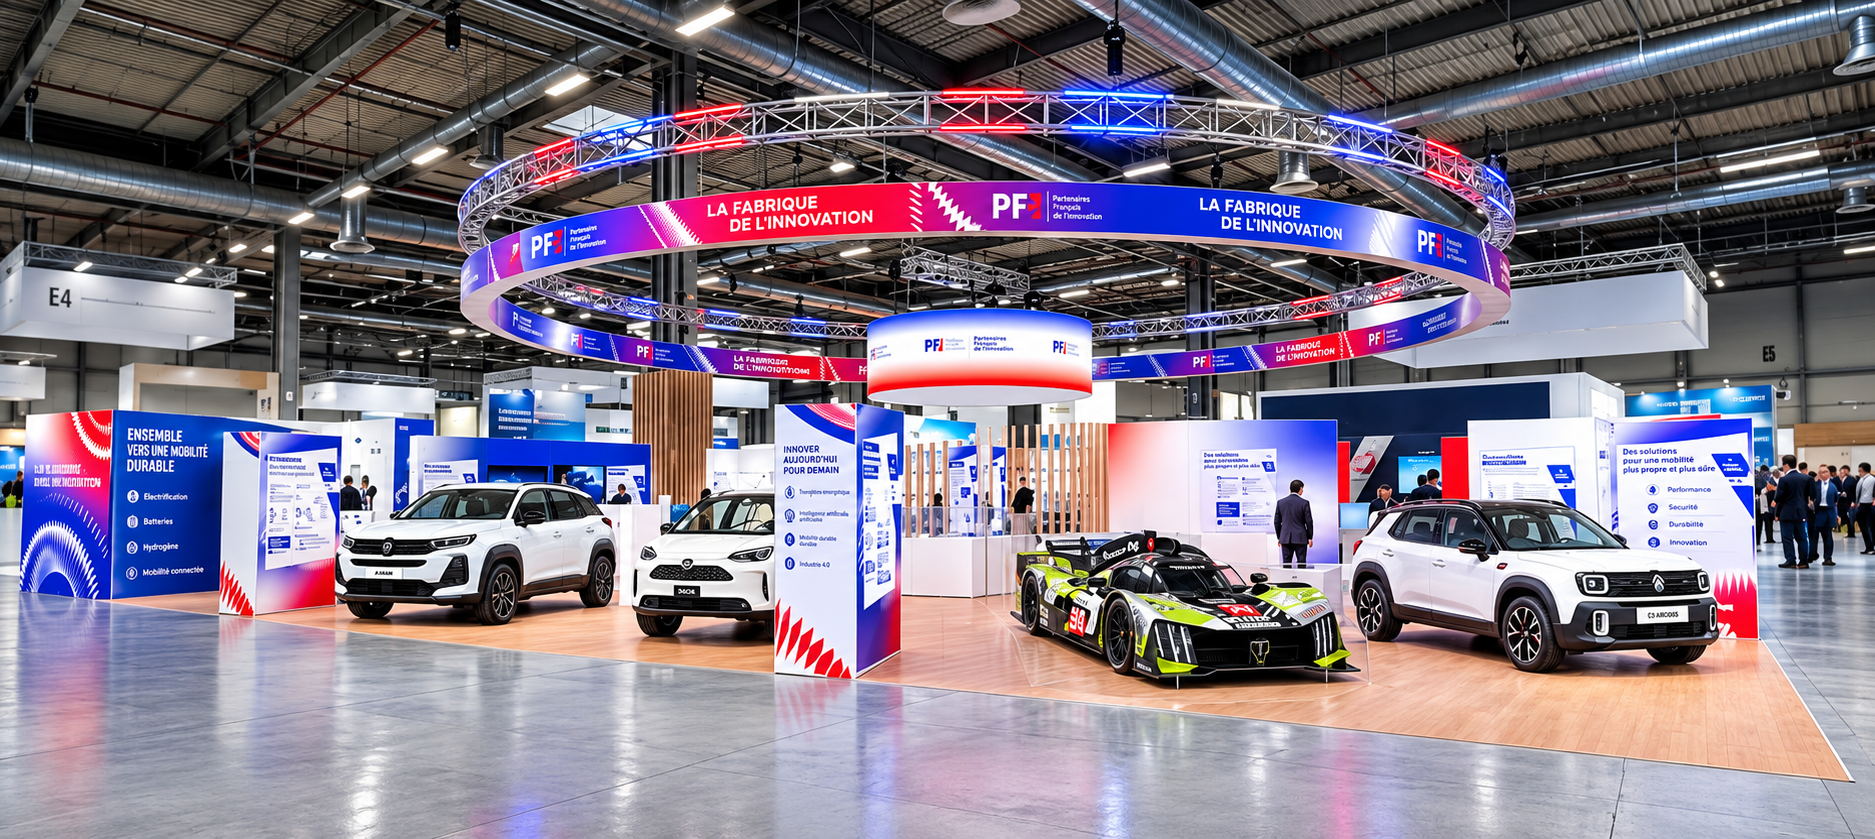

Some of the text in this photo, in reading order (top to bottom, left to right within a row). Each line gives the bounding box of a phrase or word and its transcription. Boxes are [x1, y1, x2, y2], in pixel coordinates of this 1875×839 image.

[707, 195, 818, 217] LA FABRIQUE
[1199, 198, 1301, 218] LA FABRIQUE
[730, 209, 873, 232] DE L'INNOVATION
[1221, 216, 1343, 240] DE L'INNOVATION
[50, 287, 72, 308] E4
[1276, 354, 1286, 362] DE
[1762, 345, 1776, 362] E5
[127, 428, 183, 442] ENSEMBLE
[127, 443, 208, 458] VERS UNE MOBILITÉ
[783, 445, 820, 453] INNOVER
[127, 459, 175, 472] DURABLE
[783, 455, 837, 464] AUJOURD'HUI
[783, 466, 839, 474] POUR DEMAIN
[1623, 466, 1639, 474] plus
[1641, 466, 1667, 474] propre
[1679, 465, 1696, 474] plus
[143, 517, 173, 525] Batteries
